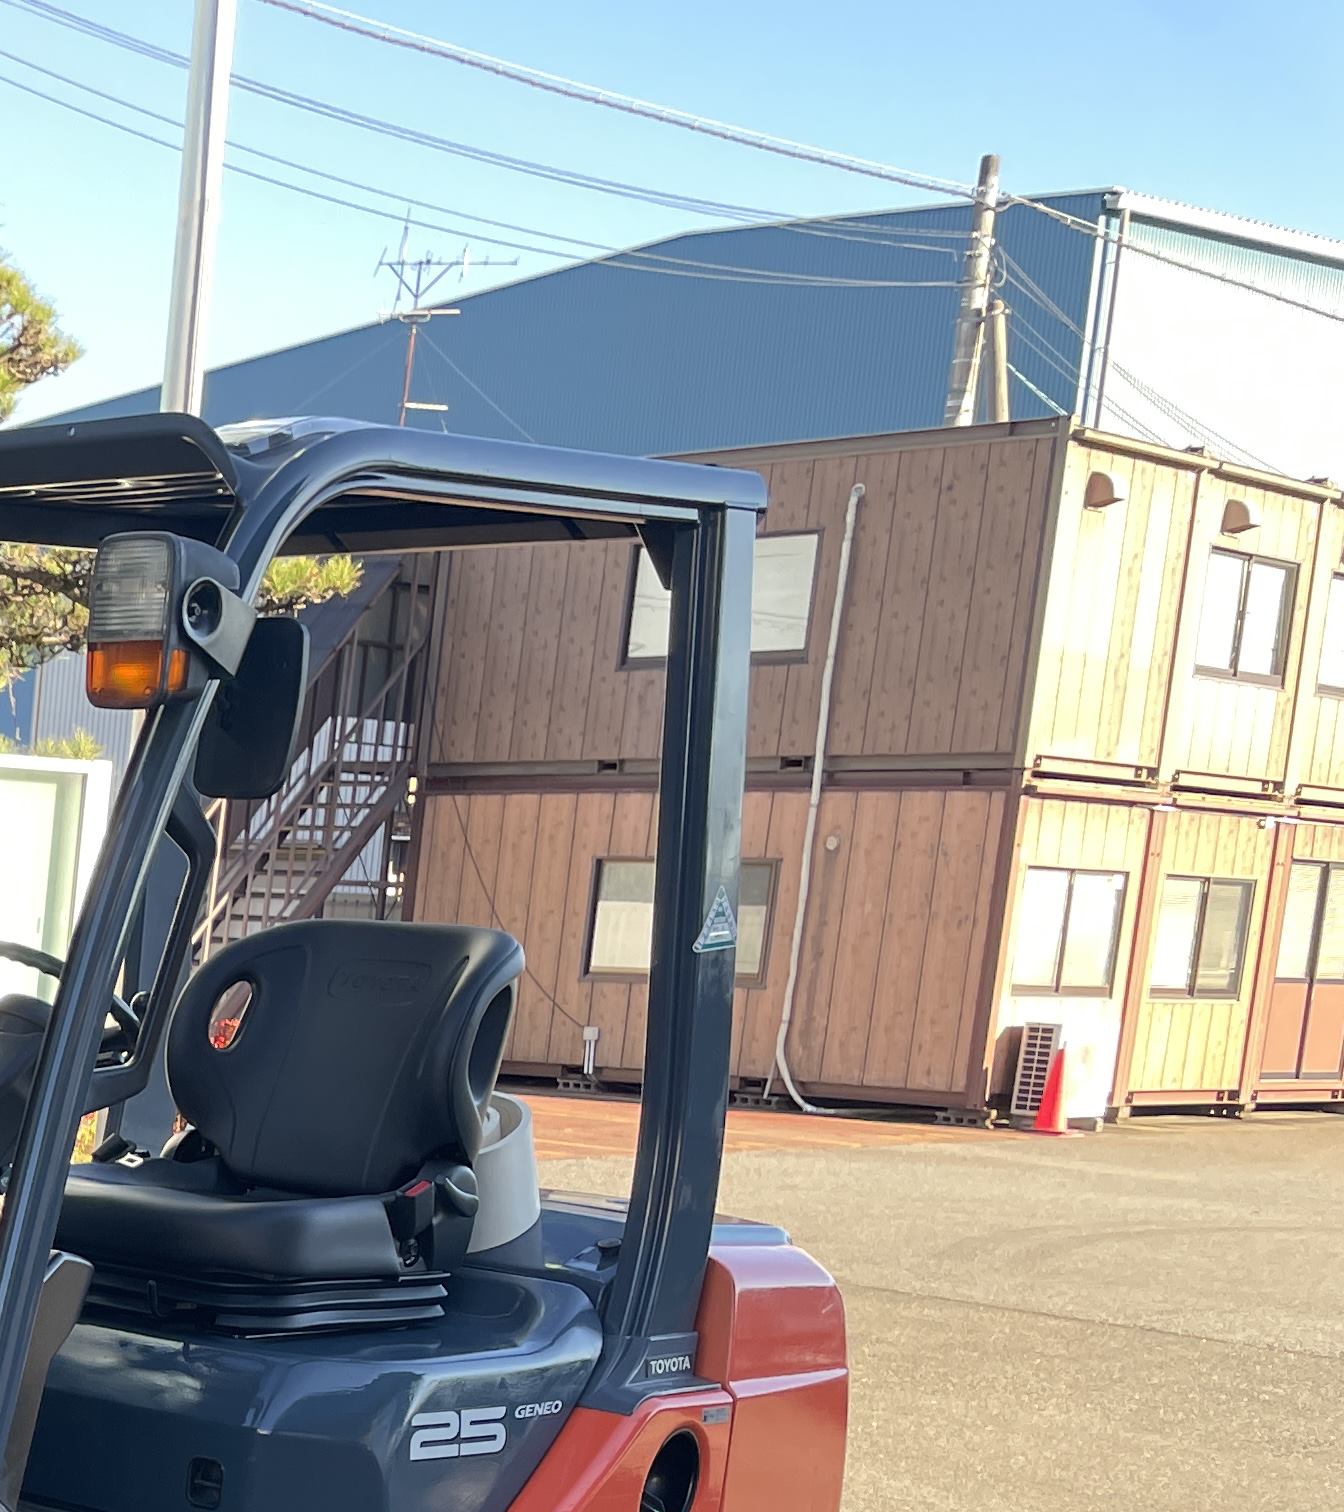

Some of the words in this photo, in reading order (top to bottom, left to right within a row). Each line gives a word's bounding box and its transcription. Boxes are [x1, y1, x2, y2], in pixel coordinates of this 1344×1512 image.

[649, 1355, 691, 1375] TOYOTA
[410, 1406, 506, 1461] 25
[514, 1400, 563, 1419] GENEO
